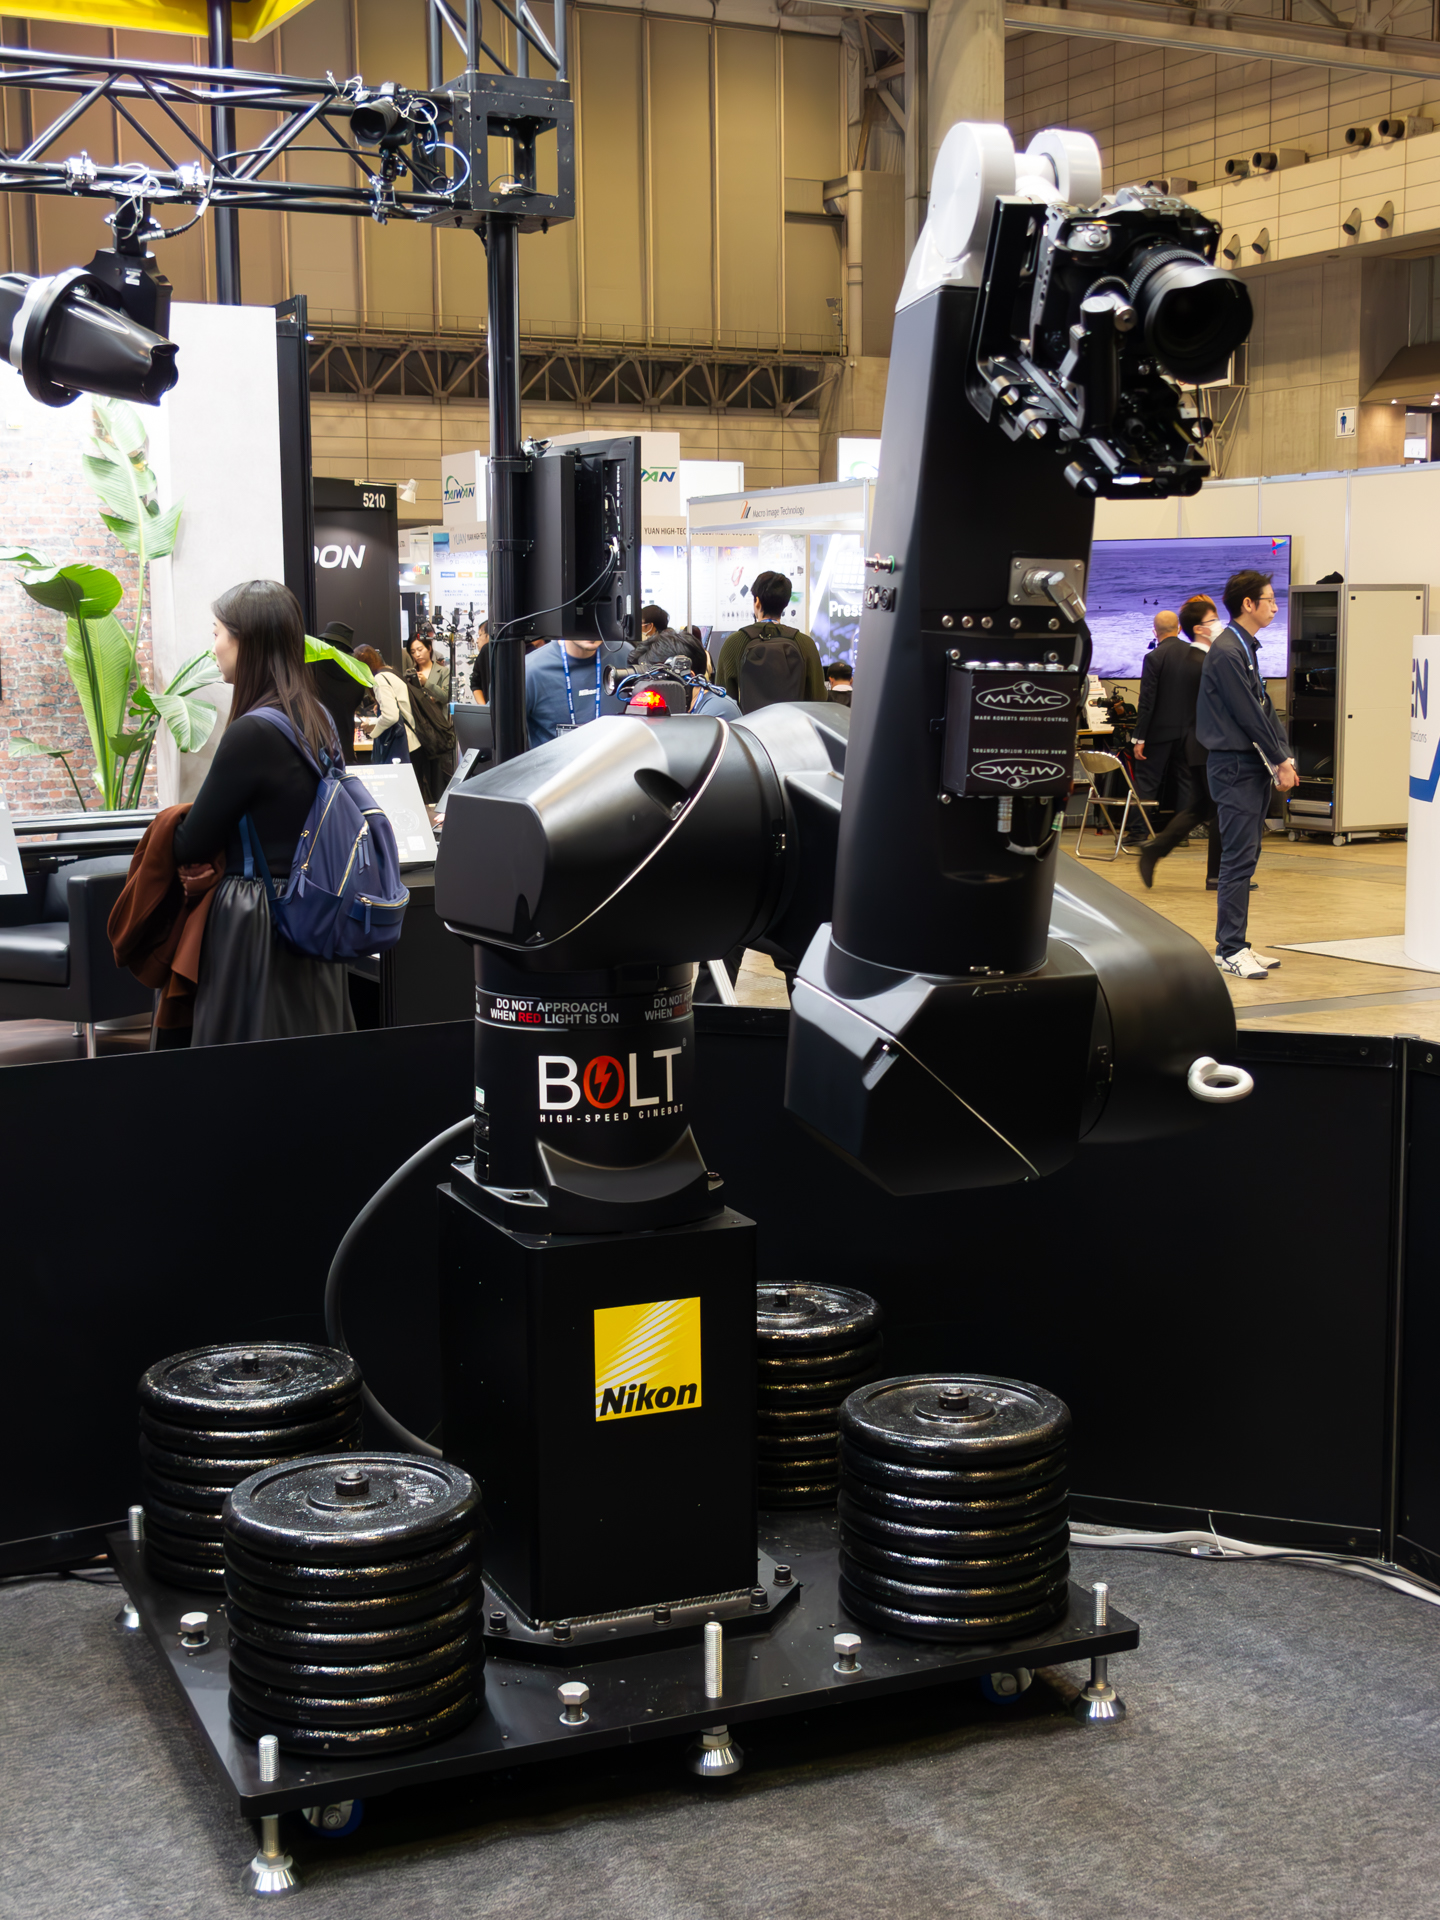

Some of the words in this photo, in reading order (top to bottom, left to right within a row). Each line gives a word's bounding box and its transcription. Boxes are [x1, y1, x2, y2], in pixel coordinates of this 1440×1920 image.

[362, 492, 386, 508] 5210
[444, 486, 475, 500] TAIWAN
[752, 510, 766, 518] Macro
[766, 508, 780, 518] Image
[780, 505, 805, 516] Technology
[644, 527, 660, 536] YUAN
[1411, 658, 1429, 720] N
[983, 694, 1063, 705] MRMC
[979, 765, 1058, 776] MRMC
[496, 998, 510, 1010] DO
[511, 1000, 534, 1012] NOT
[536, 1002, 608, 1013] APPROACH
[653, 997, 667, 1009] DO
[669, 993, 683, 1006] NOT
[490, 1008, 516, 1022] WHEN
[518, 1012, 542, 1024] RED
[544, 1013, 581, 1024] LIGHT
[585, 1013, 598, 1024] IS
[600, 1013, 620, 1024] ON
[645, 1007, 673, 1021] WHEN
[538, 1046, 682, 1110] BOLT
[539, 1111, 630, 1123] HIGH-SPEED
[638, 1103, 684, 1120] CINEBOT
[600, 1382, 698, 1417] Nikon
